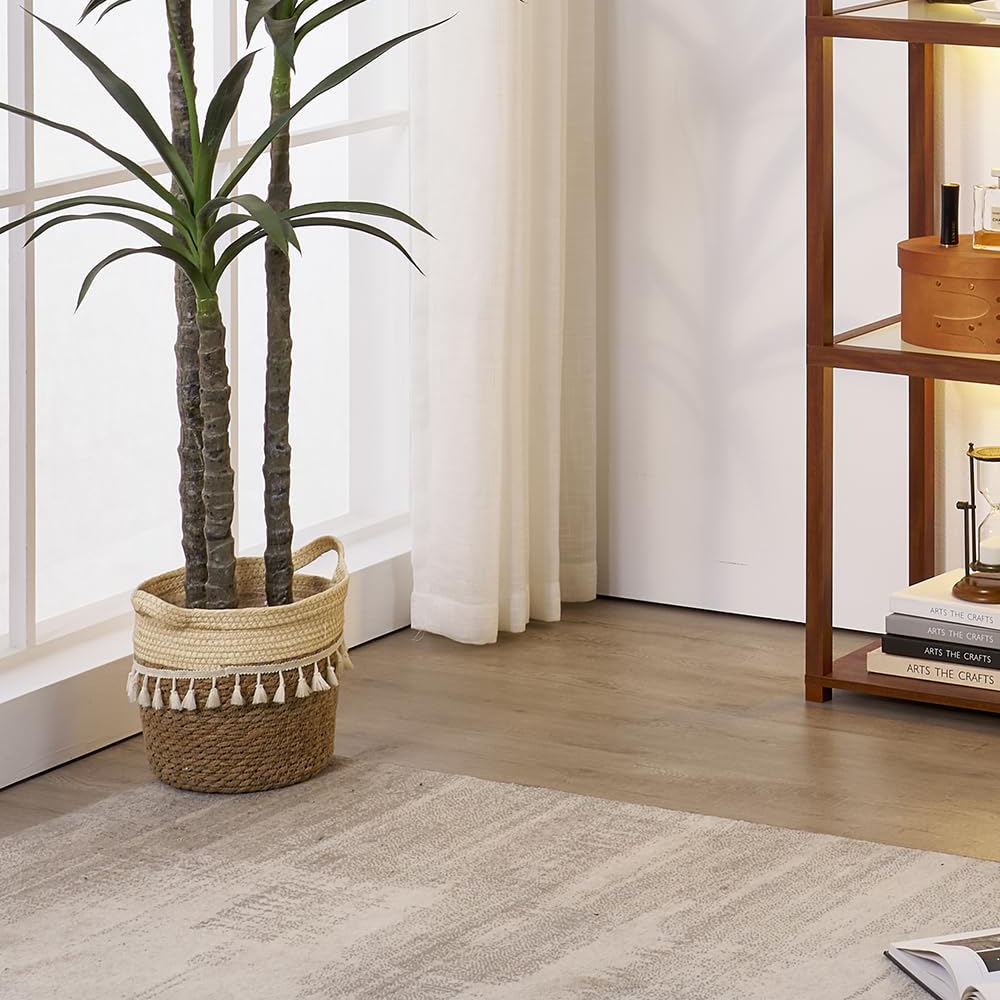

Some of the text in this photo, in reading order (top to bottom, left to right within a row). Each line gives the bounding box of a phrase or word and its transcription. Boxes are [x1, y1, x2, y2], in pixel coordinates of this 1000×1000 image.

[929, 607, 994, 624] ARTS THE CRAFTS
[927, 627, 994, 643] ARTS THE CRAFTS
[924, 647, 992, 663] ARTS THE CRAFTS
[906, 664, 995, 685] ARTS THE CRAFTS
